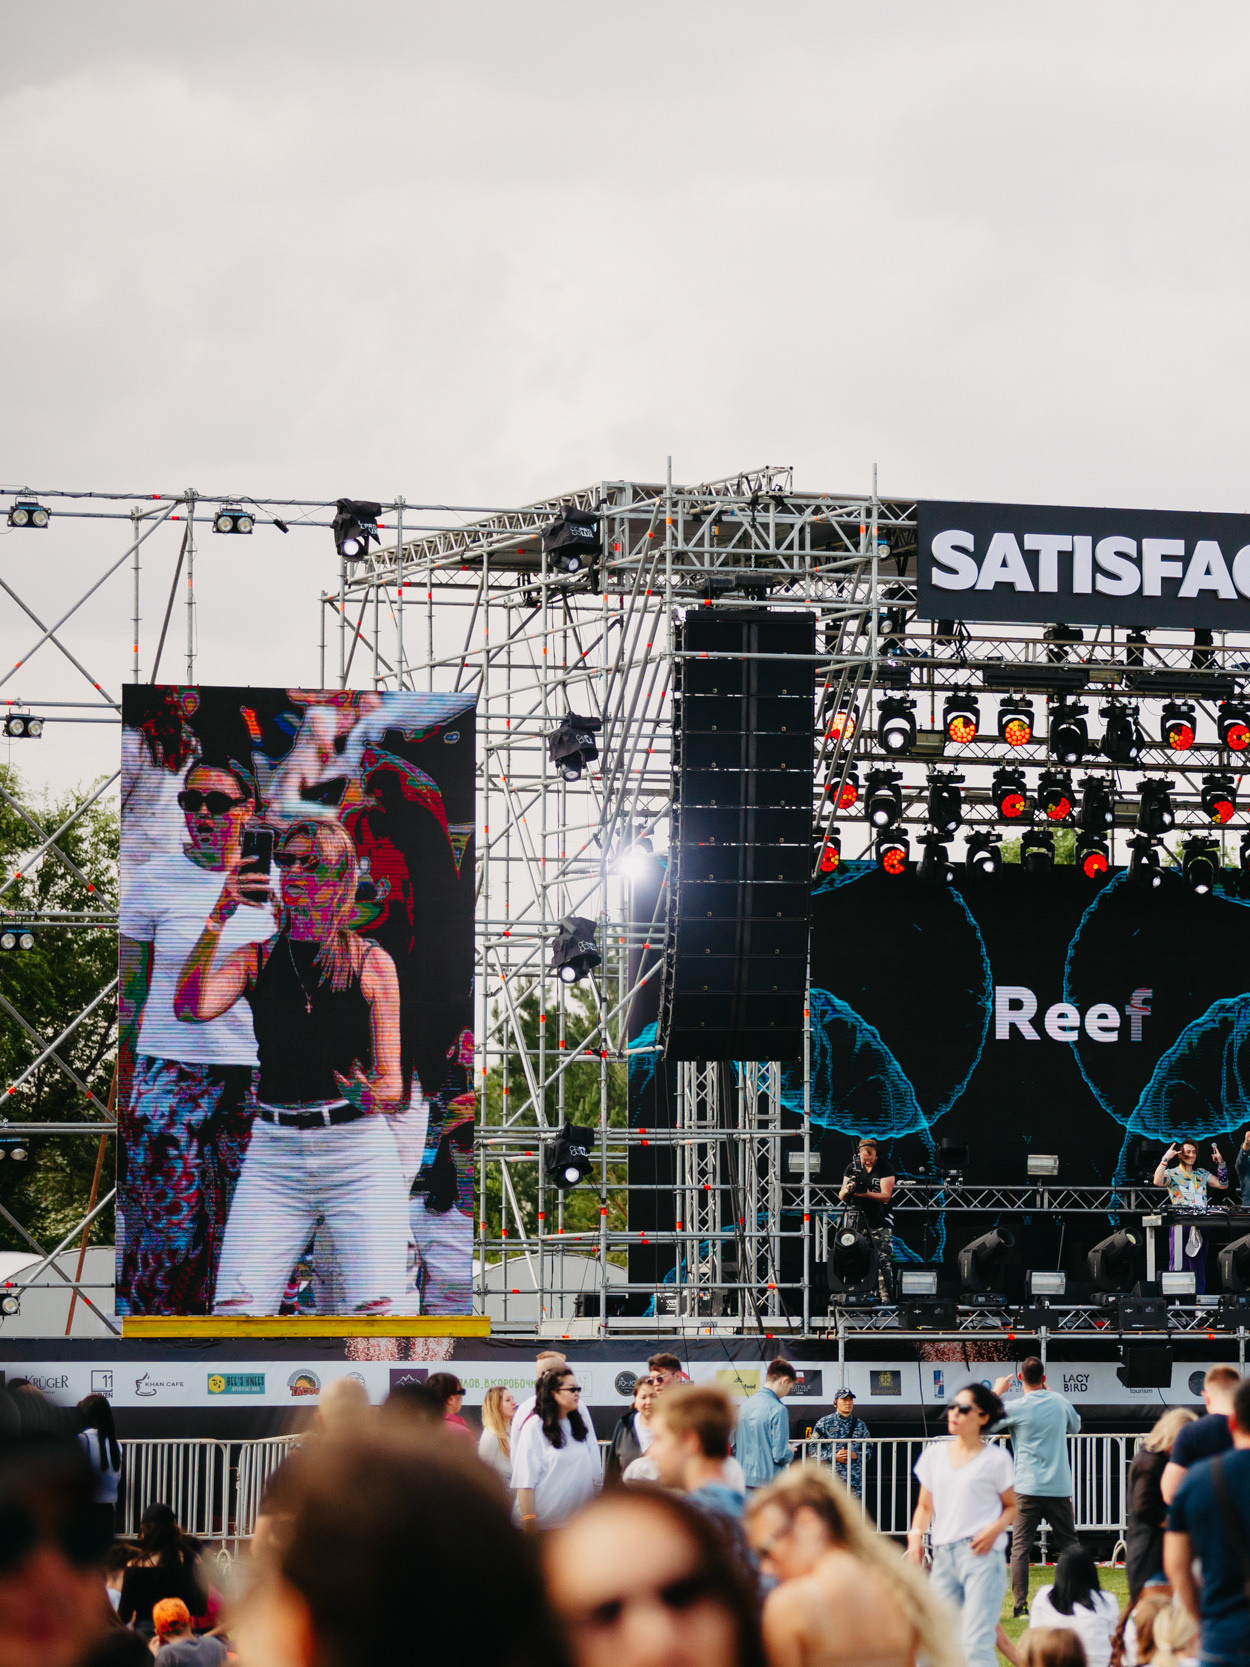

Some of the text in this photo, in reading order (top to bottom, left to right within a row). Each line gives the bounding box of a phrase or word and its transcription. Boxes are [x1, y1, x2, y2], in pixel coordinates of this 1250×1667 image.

[995, 985, 1153, 1042] Reef
[1063, 1374, 1090, 1383] LACY
[290, 1386, 320, 1396] TACOS
[1063, 1383, 1088, 1392] BIRD
